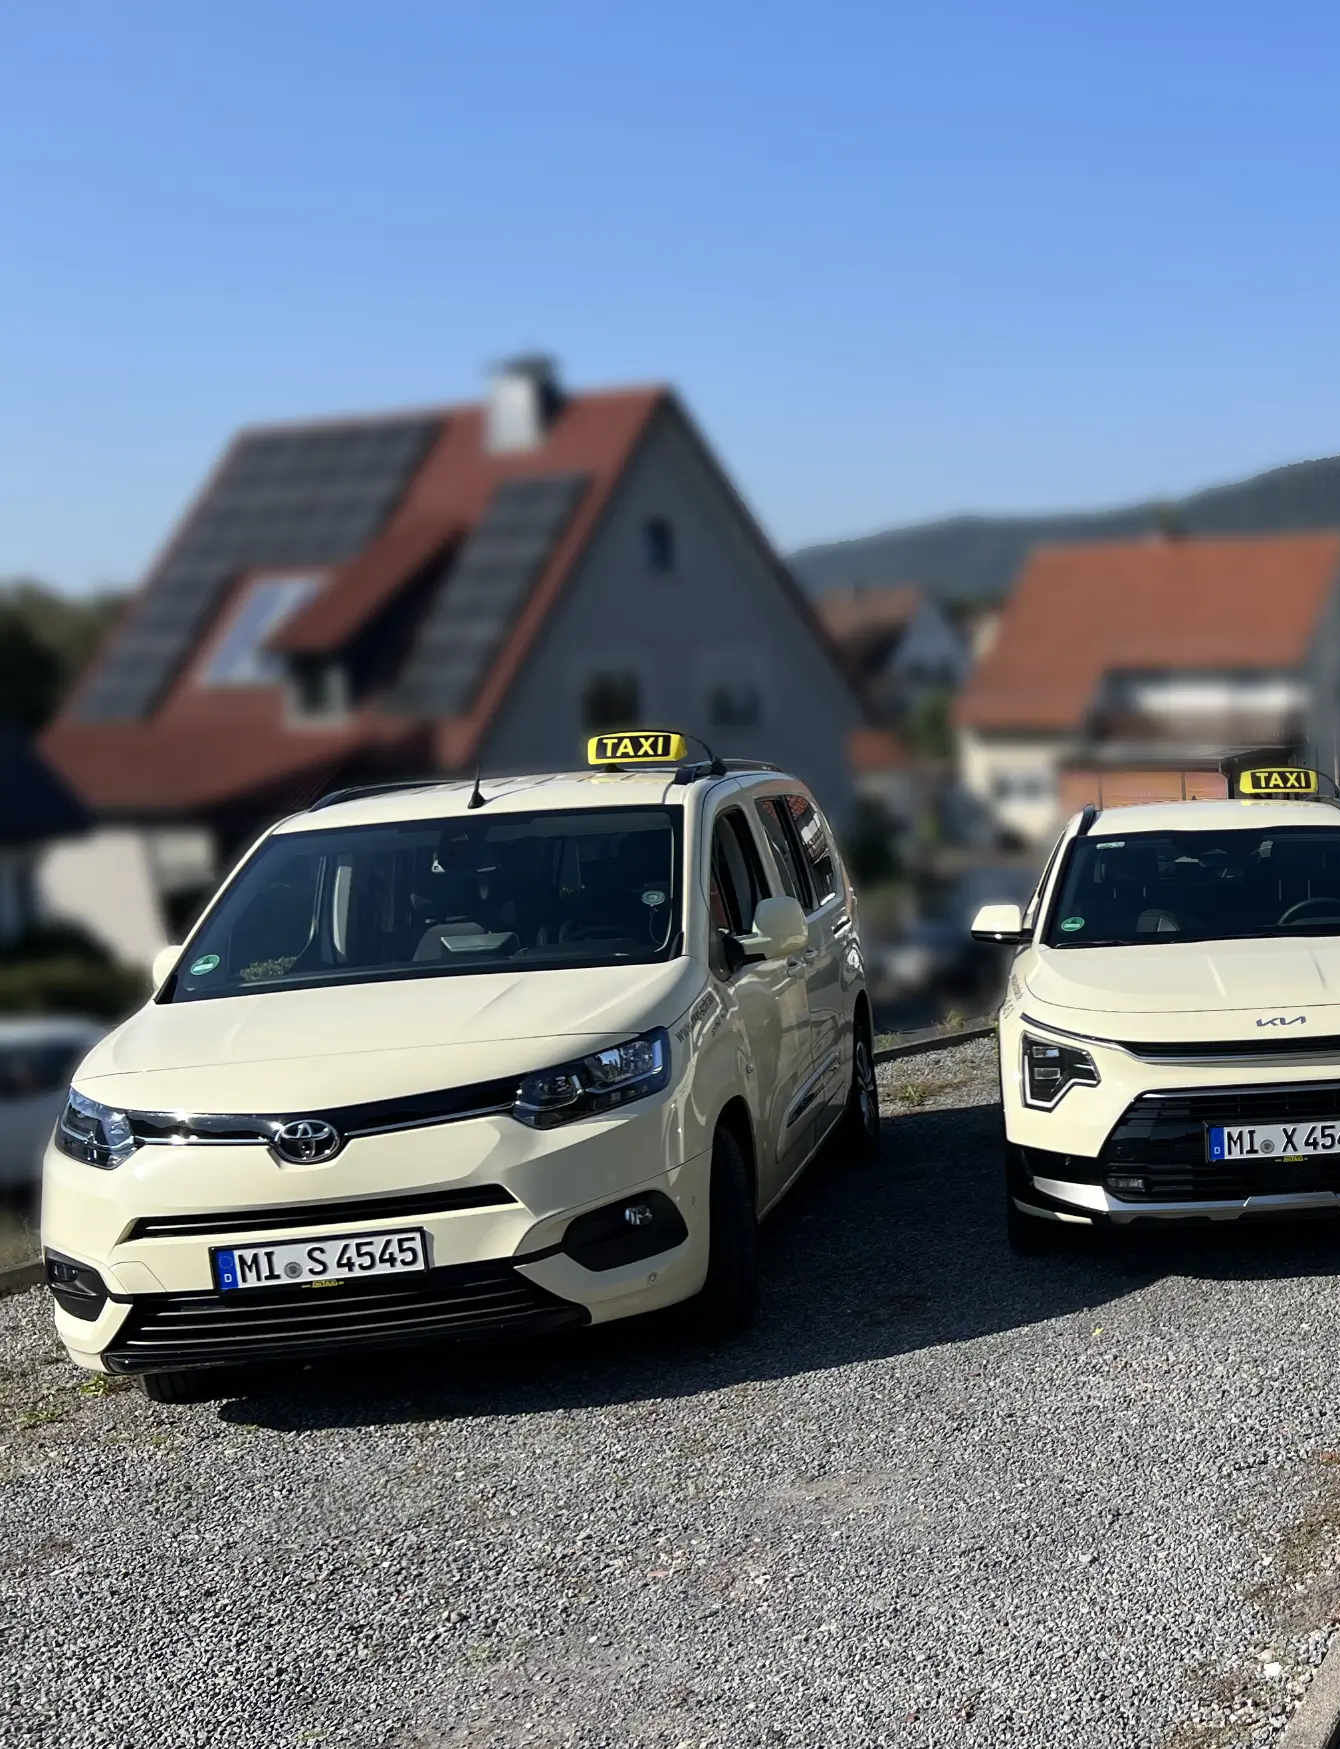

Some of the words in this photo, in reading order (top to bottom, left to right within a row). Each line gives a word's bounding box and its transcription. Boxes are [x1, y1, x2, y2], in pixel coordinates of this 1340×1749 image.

[603, 737, 664, 757] TAXI
[1256, 772, 1306, 788] TAXI
[1214, 1146, 1220, 1154] D
[1227, 1129, 1258, 1156] MI
[1282, 1127, 1298, 1152] X
[238, 1250, 281, 1283] MI
[306, 1247, 328, 1276] S
[336, 1236, 418, 1272] 4545
[224, 1273, 232, 1283] D
